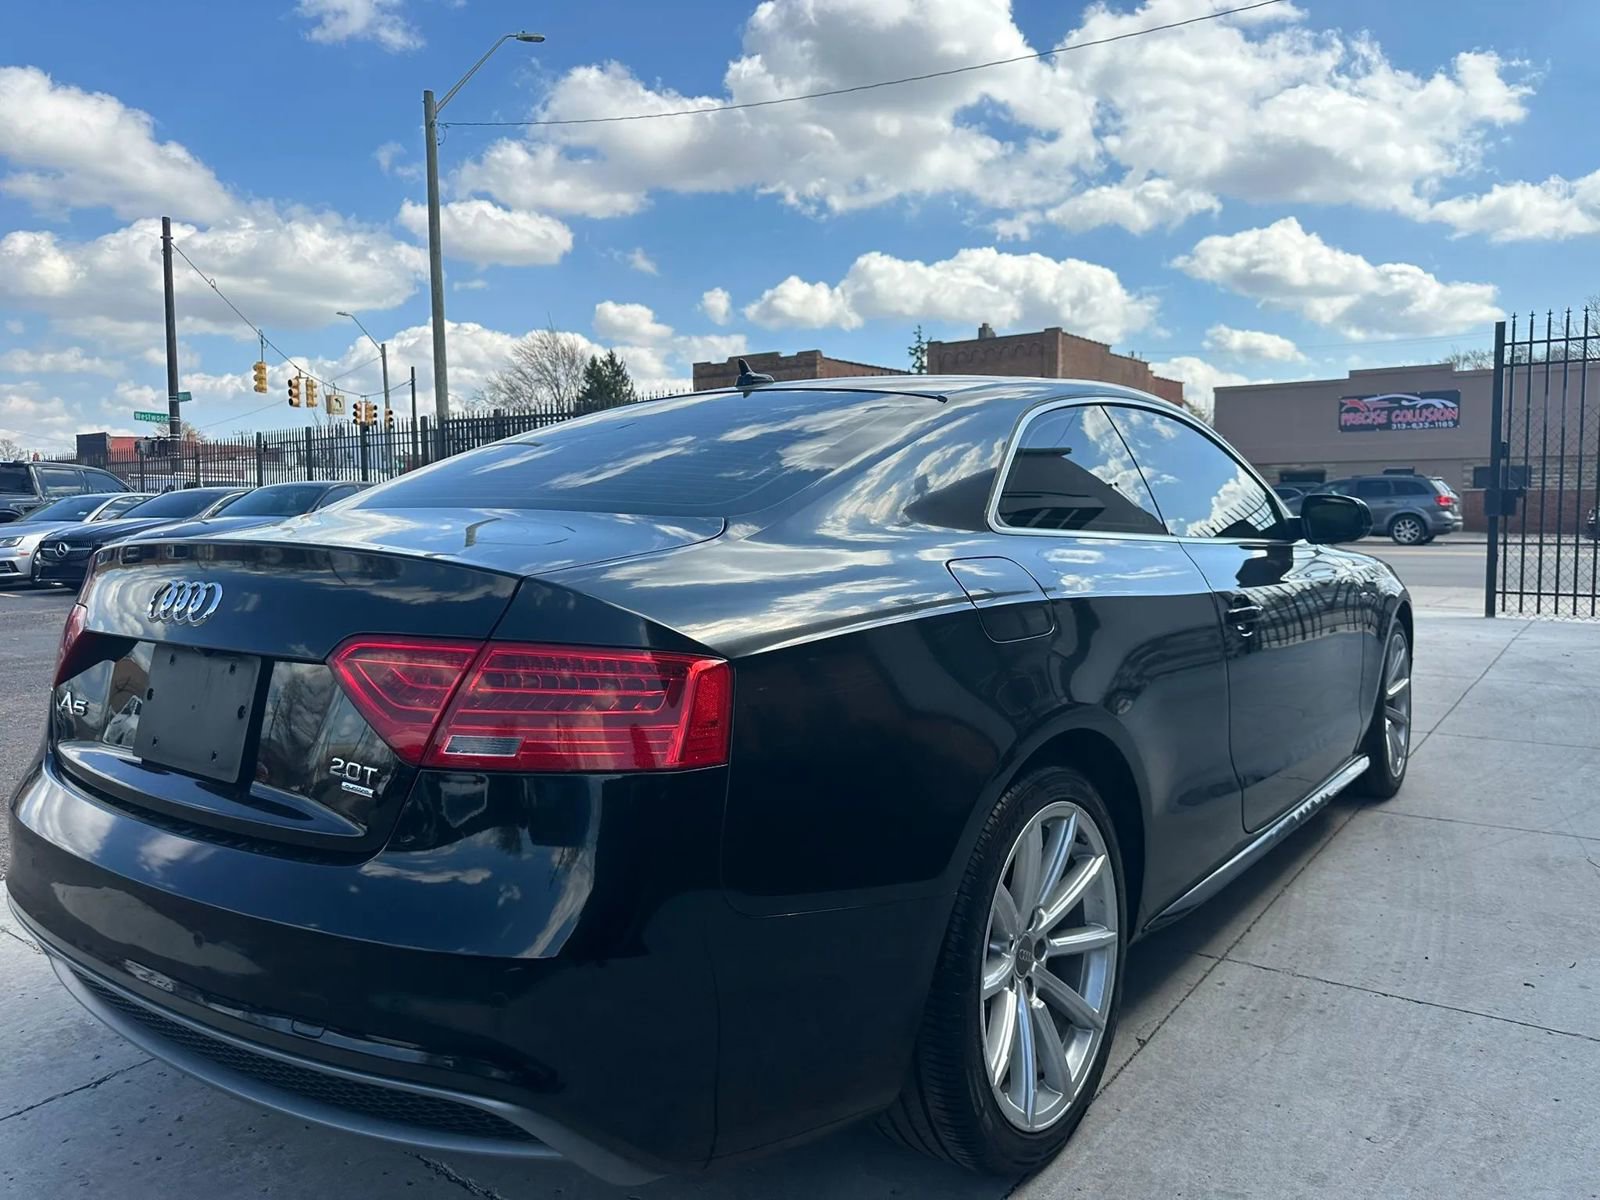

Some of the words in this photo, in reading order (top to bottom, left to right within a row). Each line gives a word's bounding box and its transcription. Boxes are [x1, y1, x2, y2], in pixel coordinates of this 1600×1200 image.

[135, 413, 168, 422] Westwood
[1392, 408, 1458, 423] COLLISION
[60, 691, 89, 716] A5
